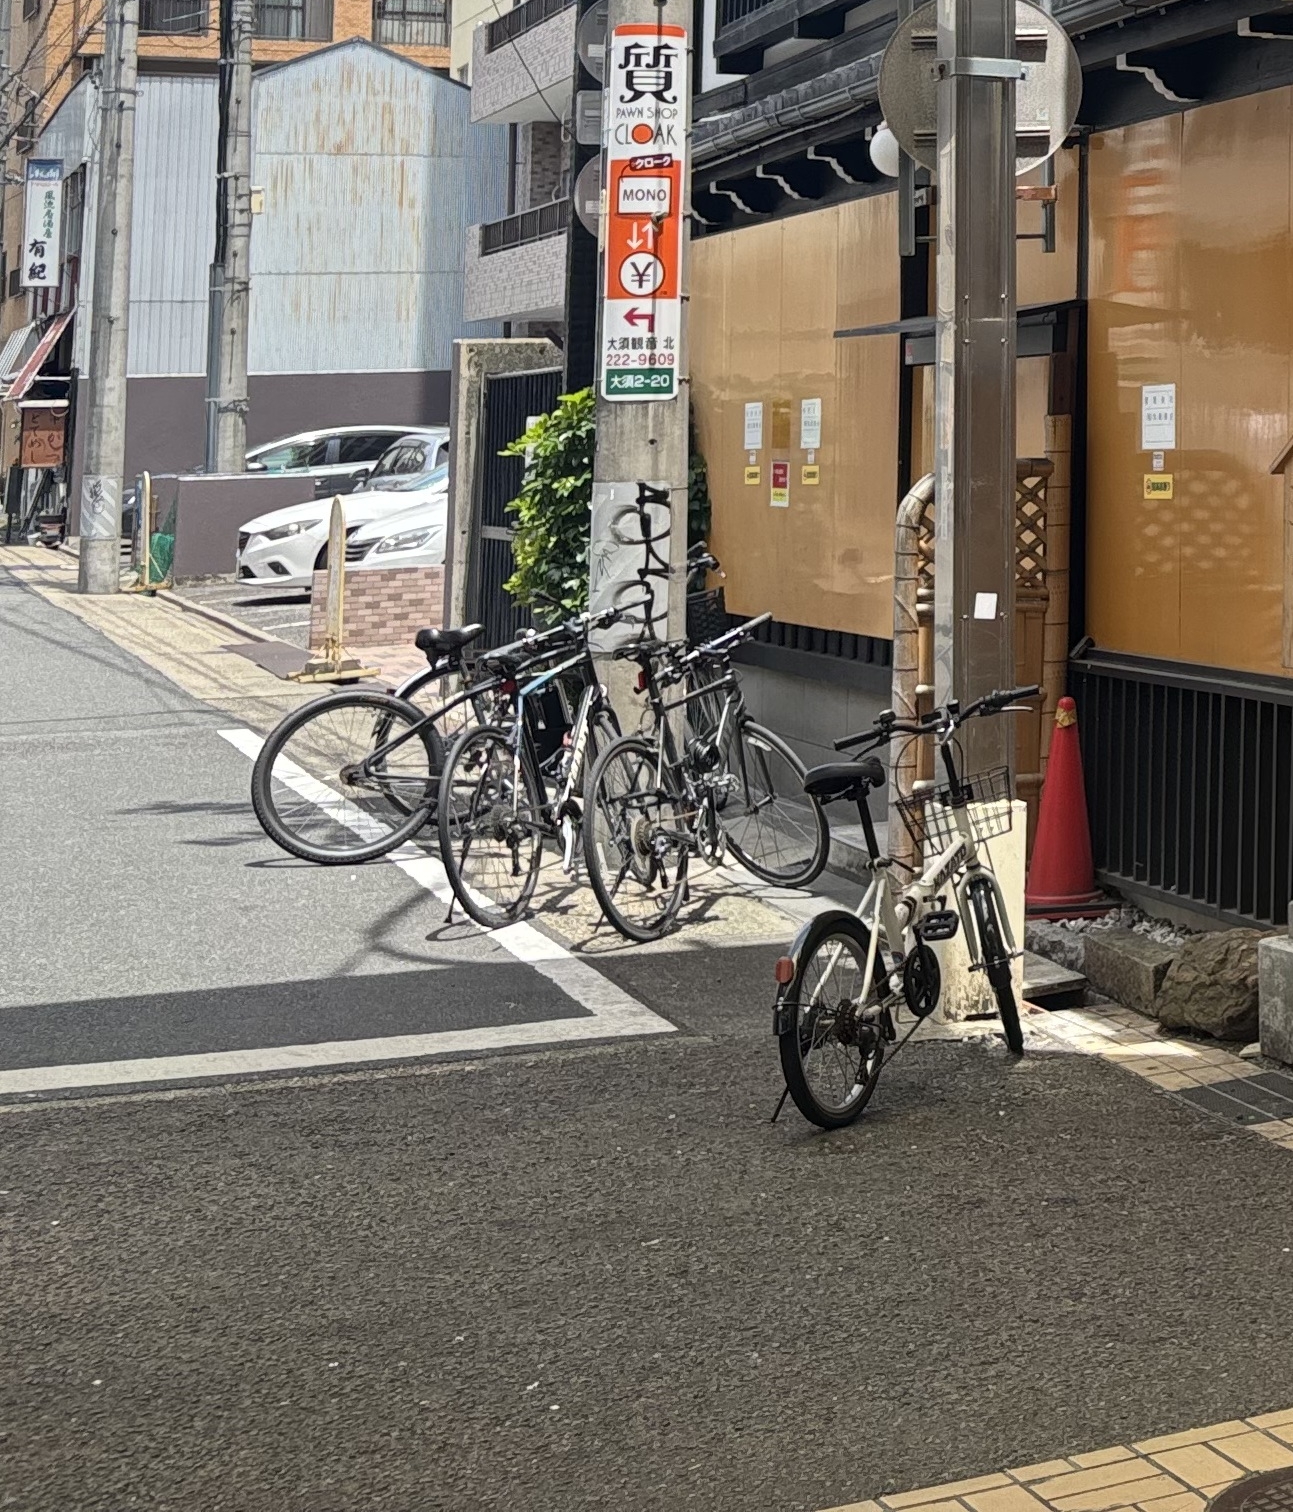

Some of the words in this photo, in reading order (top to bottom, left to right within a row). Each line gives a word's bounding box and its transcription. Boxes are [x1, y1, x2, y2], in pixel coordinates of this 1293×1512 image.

[617, 41, 679, 105] 質
[615, 107, 644, 119] PAWN
[646, 107, 679, 120] SHOP
[614, 122, 678, 146] CLOAK
[635, 155, 672, 170] クローク
[622, 188, 667, 202] MONO
[607, 336, 658, 351] 大須観音
[606, 353, 675, 366] 222-9609
[610, 374, 671, 390] 大須2-20
